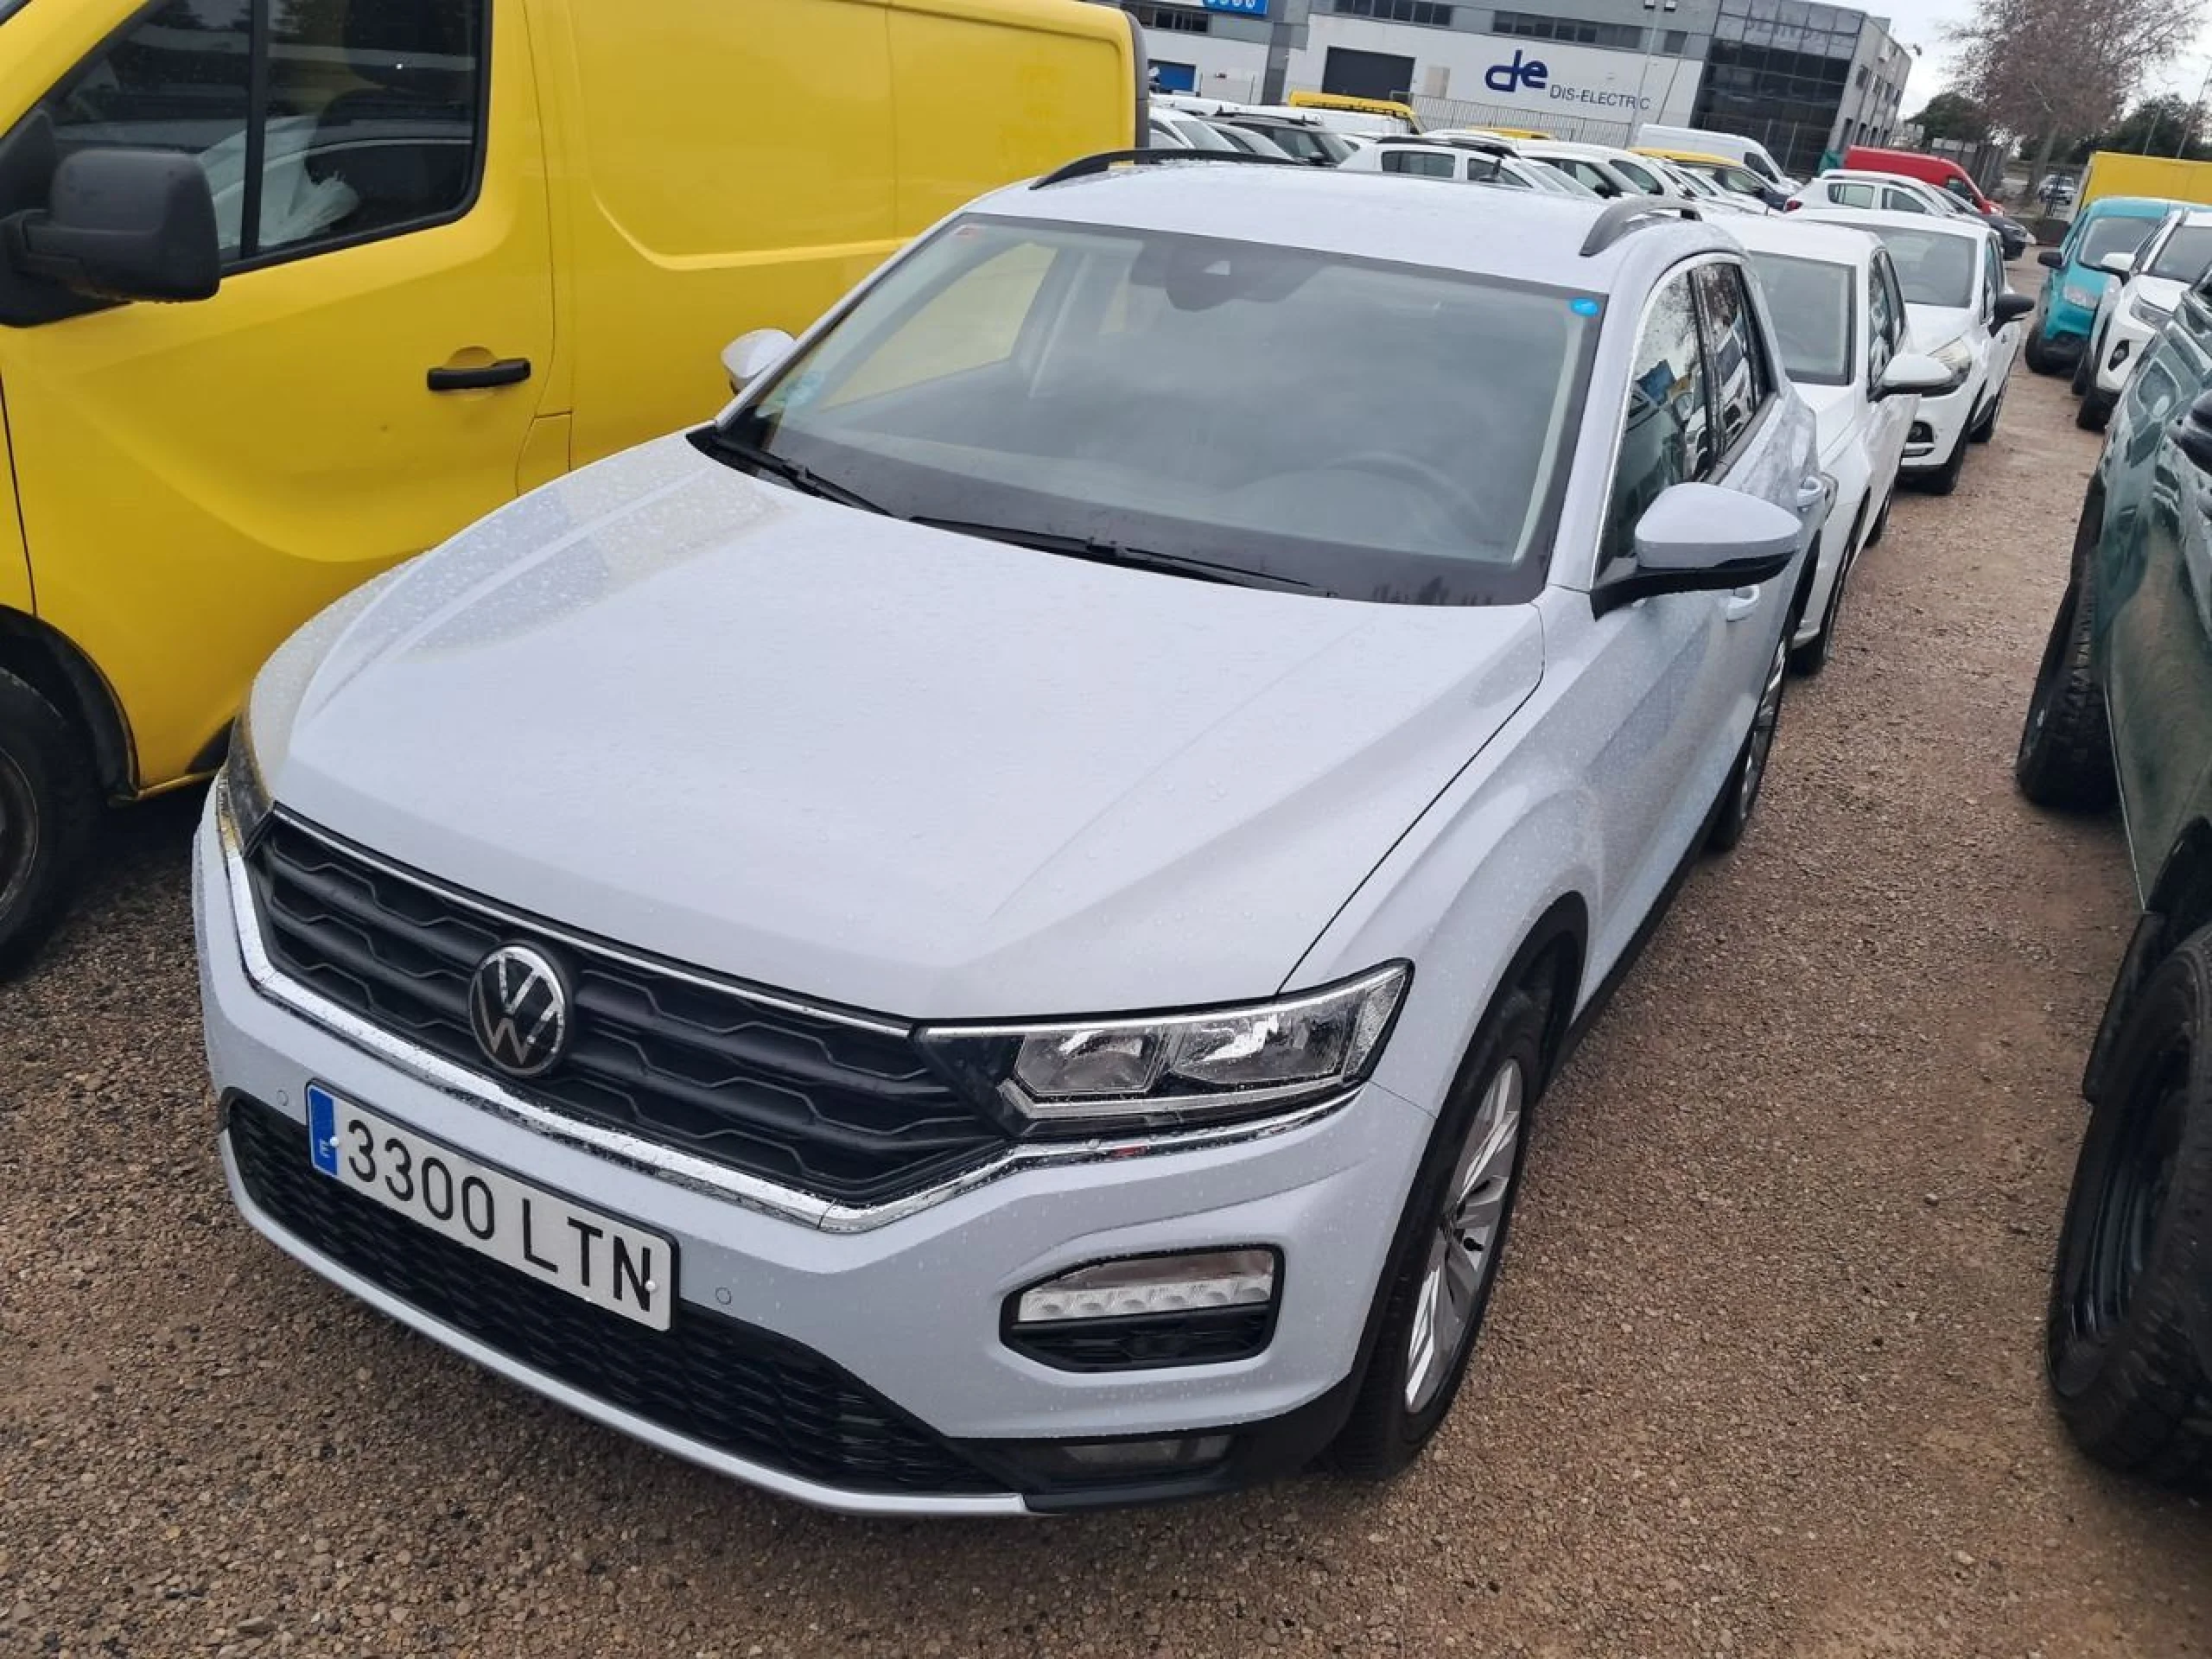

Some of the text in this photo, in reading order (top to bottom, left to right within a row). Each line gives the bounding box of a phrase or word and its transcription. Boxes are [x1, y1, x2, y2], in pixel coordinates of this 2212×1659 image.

[1549, 84, 1651, 110] DIS-ELECTRC
[319, 1138, 330, 1159] E
[348, 1119, 652, 1313] 3300 LTN
